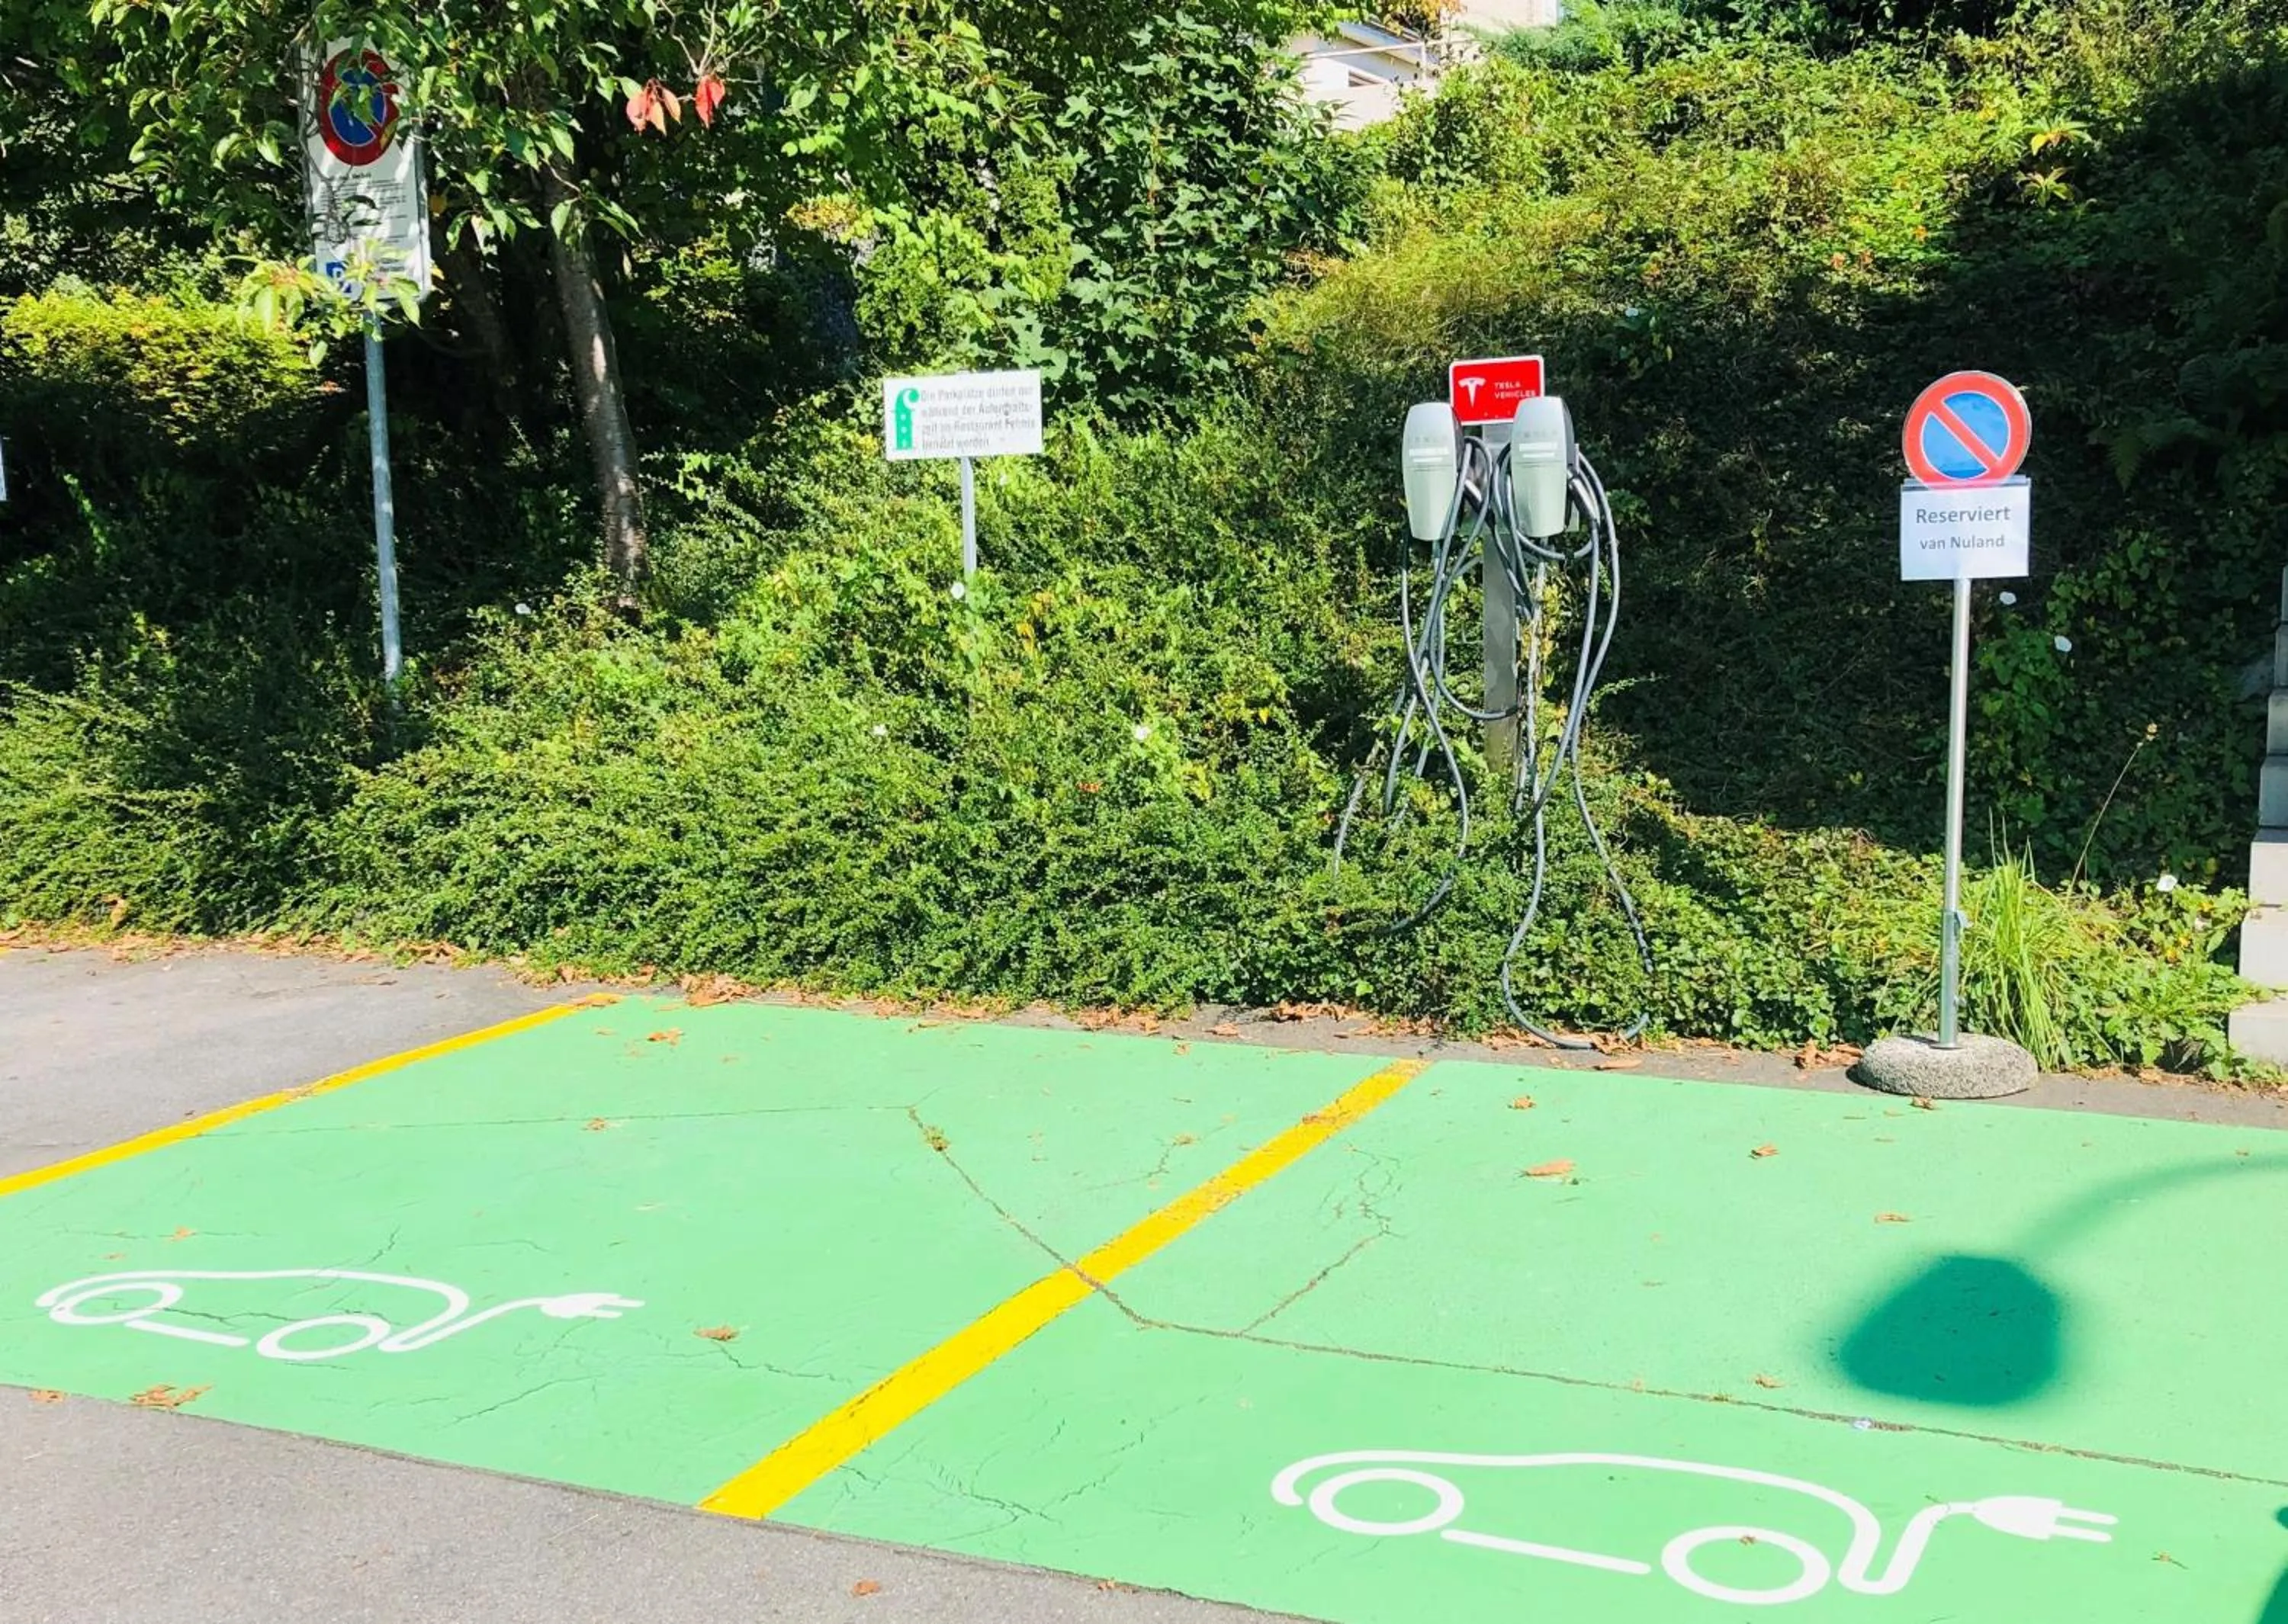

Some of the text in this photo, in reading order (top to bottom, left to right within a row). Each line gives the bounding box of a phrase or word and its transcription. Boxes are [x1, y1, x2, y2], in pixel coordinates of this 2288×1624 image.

[1494, 381, 1521, 390] TESLA
[937, 388, 984, 400] Parkplätze
[1494, 390, 1536, 400] VEHICLES
[954, 419, 1002, 432] Restaurant
[1916, 505, 2012, 524] Reserviert
[1919, 534, 2005, 550] van Nuland
